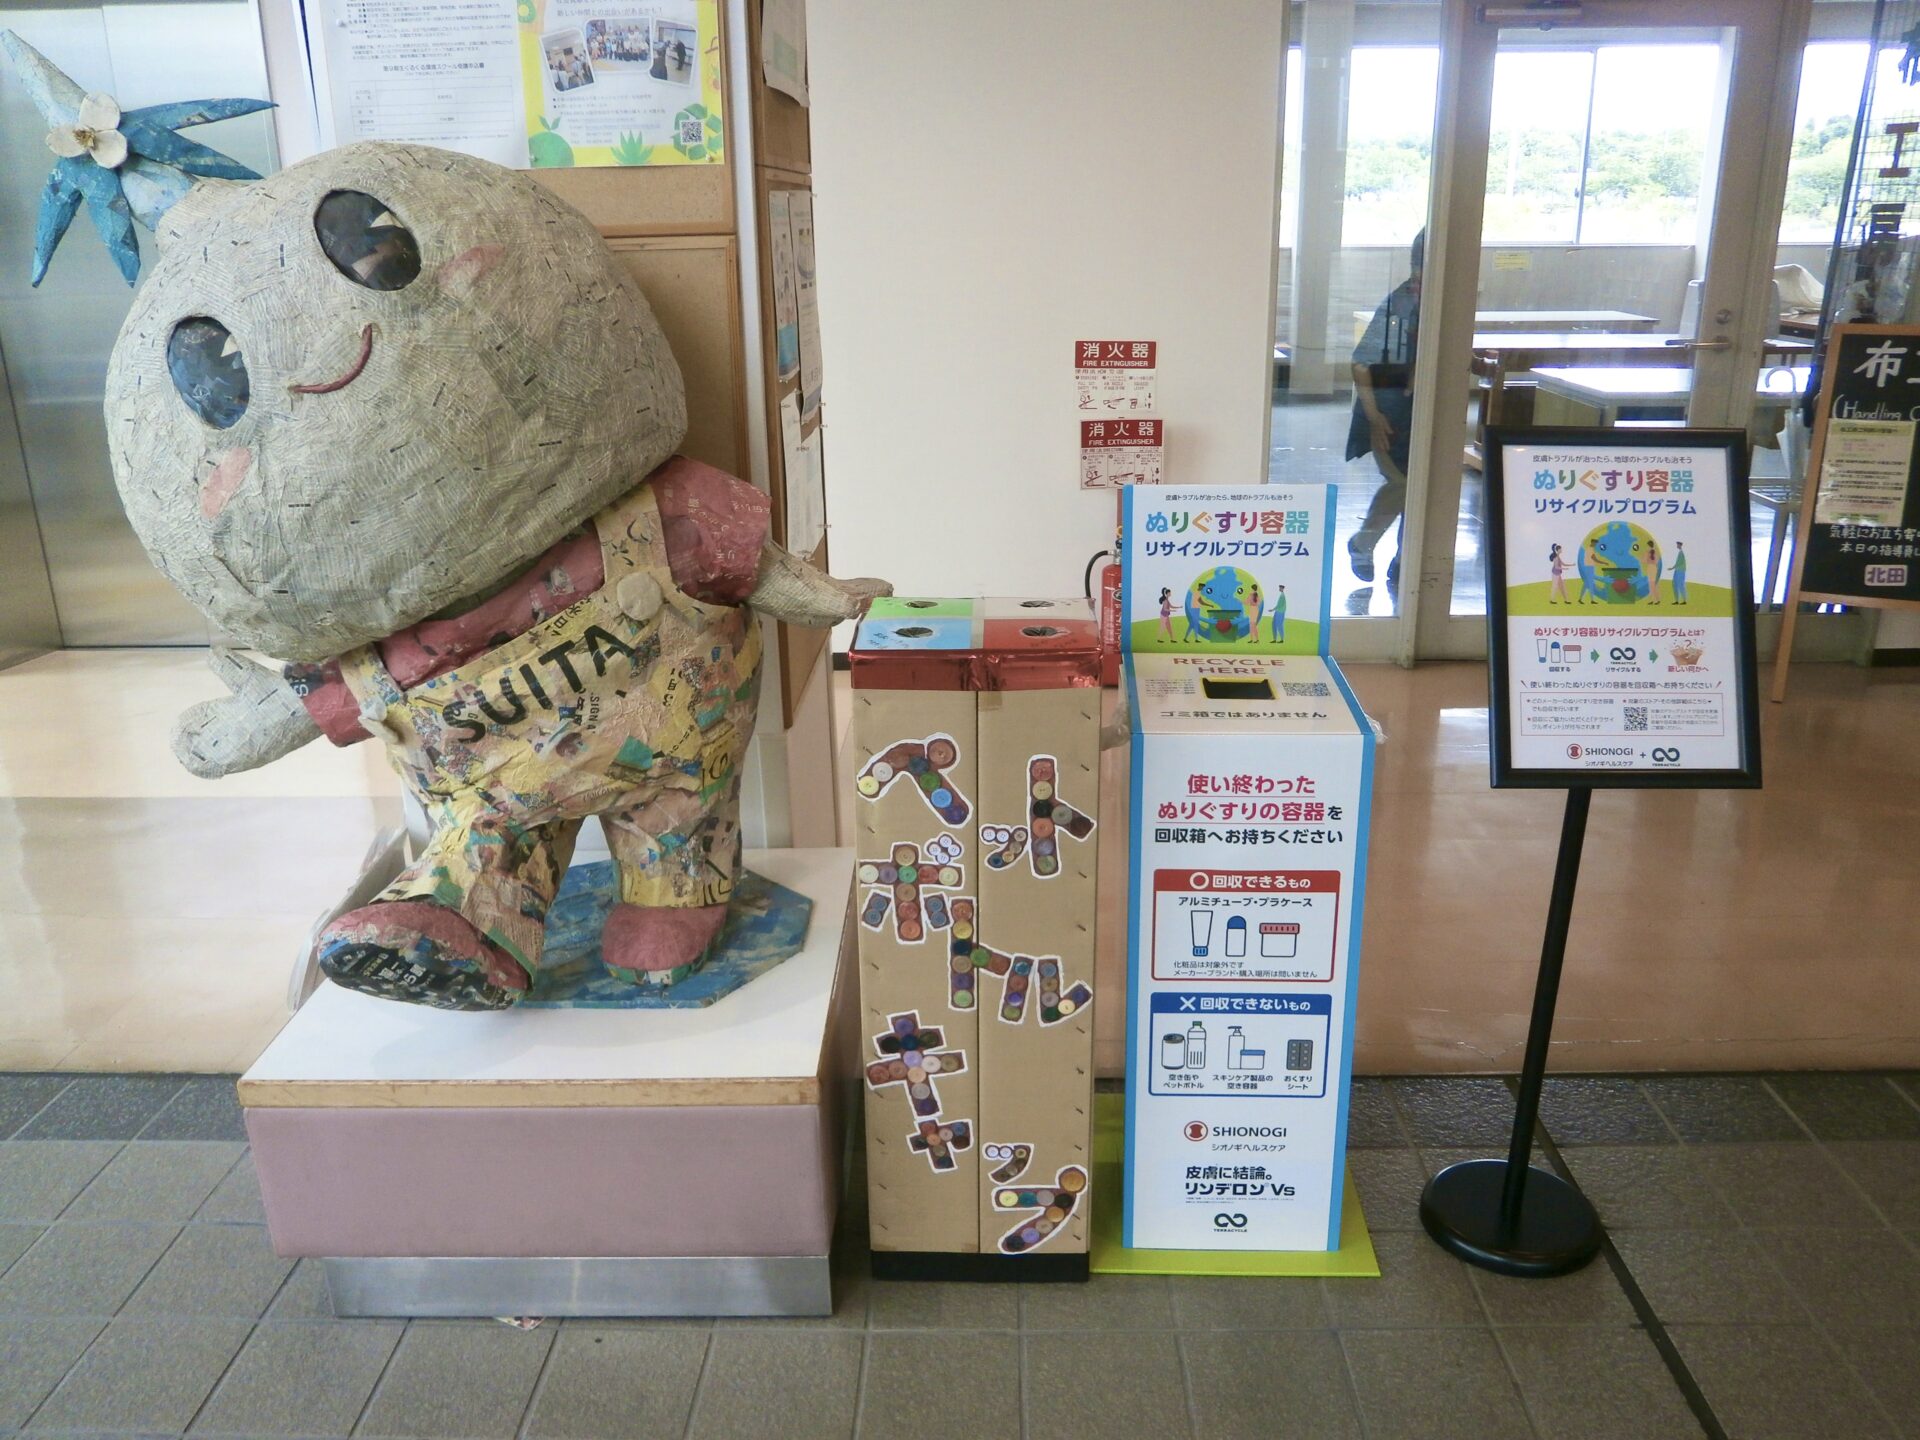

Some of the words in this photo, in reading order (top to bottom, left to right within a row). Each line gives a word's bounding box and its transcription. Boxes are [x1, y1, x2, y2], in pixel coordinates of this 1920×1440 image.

[1083, 343, 1149, 358] 消火器
[1088, 421, 1154, 437] 消火器
[1107, 438, 1155, 446] EXTINGUISHER
[1533, 469, 1694, 493] ぬりぐすり容器
[1534, 498, 1697, 515] リサイクルプログラム
[1145, 510, 1309, 534] ぬりぐすり容器
[1829, 524, 1920, 542] 気軽にお立ち寄
[1145, 540, 1310, 557] リサイクルプログラム
[1867, 567, 1905, 584] 北田
[1173, 657, 1286, 667] RECYCLE
[1198, 666, 1267, 675] HERE
[442, 624, 636, 743] SUITA
[1160, 710, 1328, 719] ゴミ箱ではありません
[1585, 747, 1634, 756] SHIONOGI
[1187, 774, 1316, 794] 使い終わった
[1157, 801, 1343, 822] ぬりぐすりの容器を
[1154, 828, 1343, 845] 回収箱へお持ちください
[1178, 896, 1313, 907] アルミチューブ・プラケース
[1173, 961, 1244, 969] 化粧品は対象外です
[1283, 1075, 1313, 1083] おくすり
[1213, 1126, 1287, 1138] SHIONOGI
[1211, 1143, 1286, 1152] シオノギヘルスケア
[1185, 1165, 1273, 1180] 皮膚に結論。
